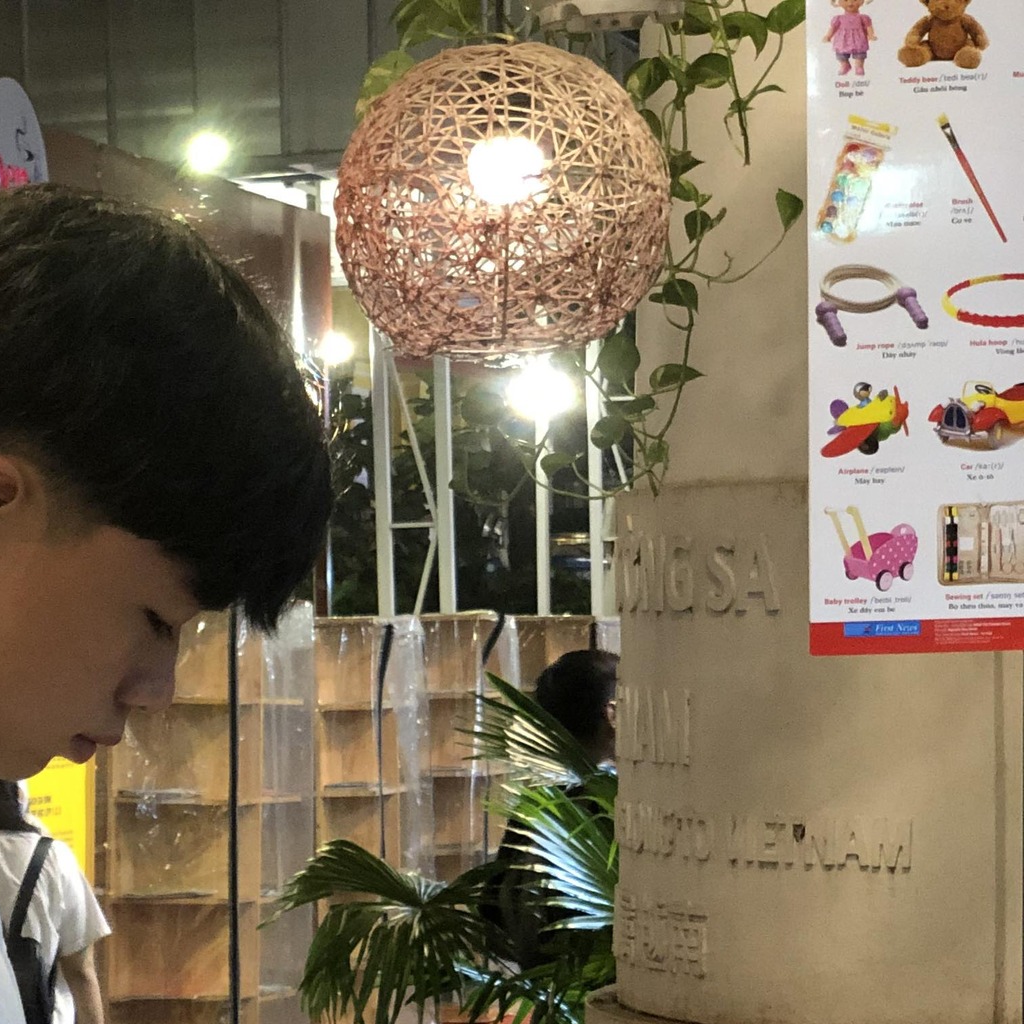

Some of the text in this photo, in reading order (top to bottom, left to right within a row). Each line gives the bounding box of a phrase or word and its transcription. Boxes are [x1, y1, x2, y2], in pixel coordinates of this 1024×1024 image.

[899, 76, 921, 84] Teddy
[856, 343, 876, 351] Jump
[877, 342, 895, 350] rope
[838, 467, 869, 475] Airplane
[960, 463, 973, 471] Car
[945, 593, 972, 601] Sewing
[824, 598, 843, 606] Baby
[844, 597, 868, 605] trolley
[875, 623, 918, 632] First News
